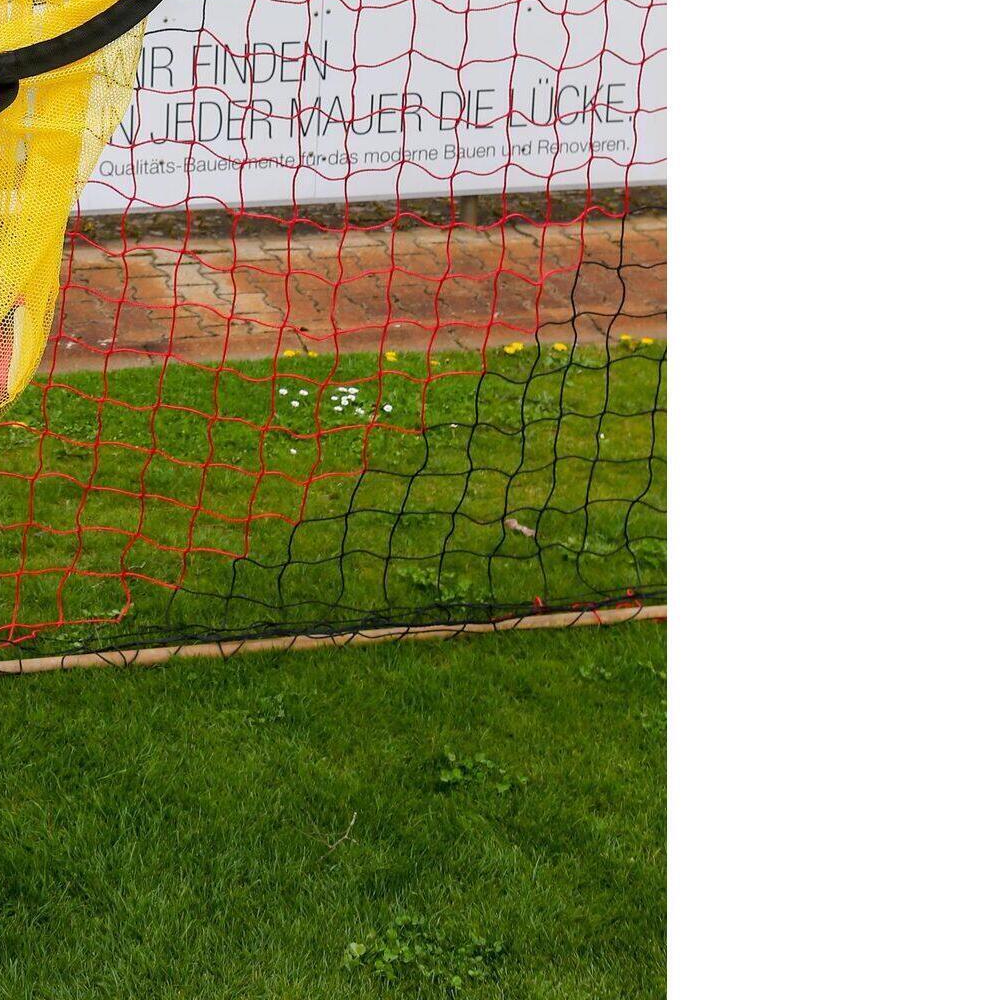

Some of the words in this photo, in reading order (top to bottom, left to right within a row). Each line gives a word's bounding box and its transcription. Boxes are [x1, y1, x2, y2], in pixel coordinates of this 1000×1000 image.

[192, 40, 328, 86] FINDEN
[150, 98, 274, 145] JEDER
[289, 93, 423, 138] MAUER
[439, 88, 496, 131] DIE
[509, 78, 633, 129] LÜCKE.
[99, 154, 296, 177] Qualitäts-Bauelemente
[327, 149, 359, 166] das
[364, 146, 438, 164] moderne
[443, 144, 496, 160] Bauen
[502, 140, 533, 157] und
[537, 138, 630, 155] Renovieren.
